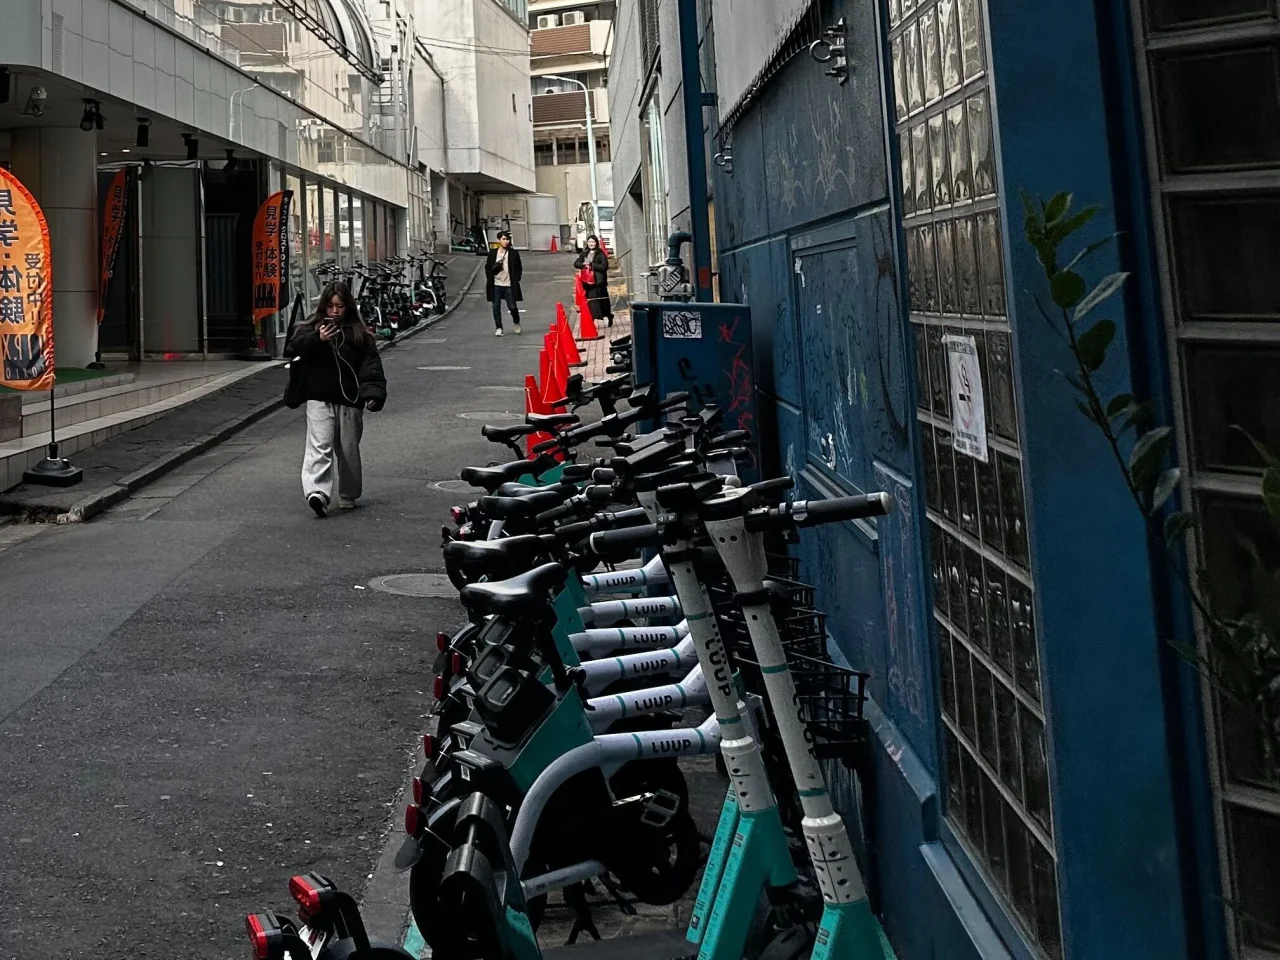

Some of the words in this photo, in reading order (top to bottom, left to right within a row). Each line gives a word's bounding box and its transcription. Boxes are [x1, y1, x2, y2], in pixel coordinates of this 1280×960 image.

[263, 205, 277, 278] 見学・体験
[606, 576, 636, 588] LUUP
[635, 604, 666, 615] LUUP
[633, 633, 668, 644] LUUP
[633, 658, 668, 674] LUUP
[704, 638, 732, 697] LUUP
[634, 694, 673, 711] LUUP
[651, 739, 692, 754] LUUP
